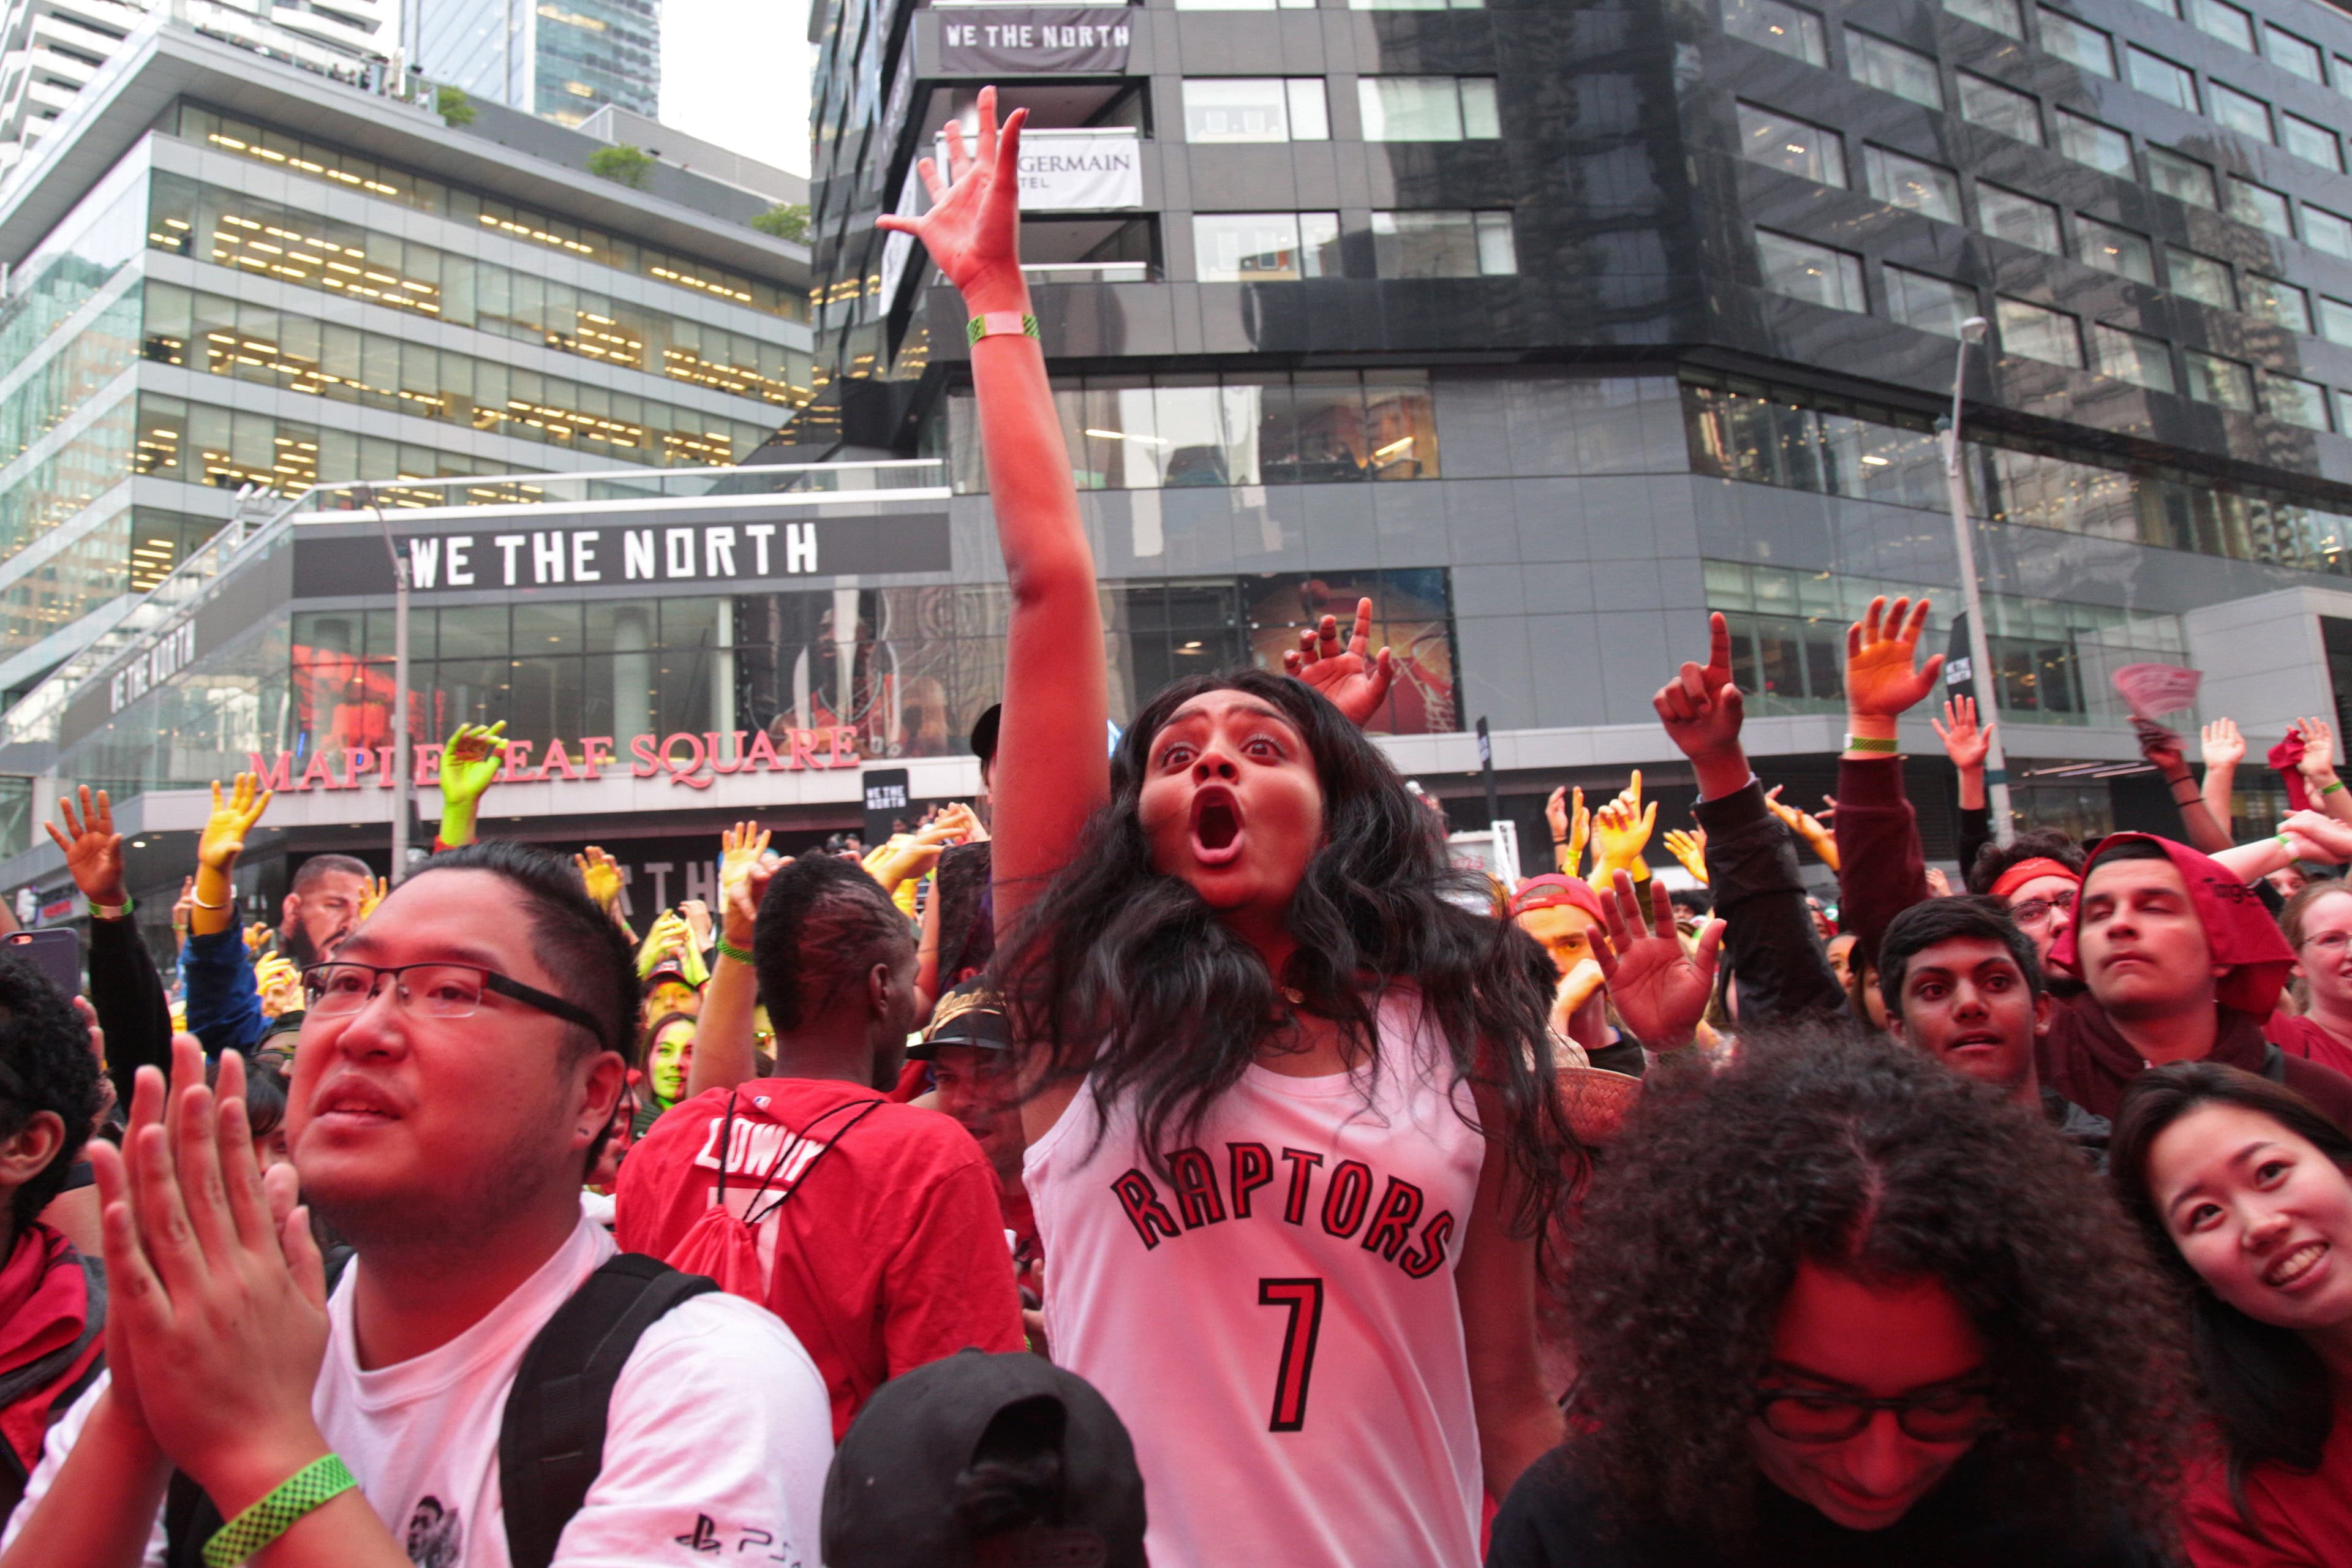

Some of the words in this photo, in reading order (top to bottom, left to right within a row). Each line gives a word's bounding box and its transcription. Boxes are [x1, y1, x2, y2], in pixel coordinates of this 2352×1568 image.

[946, 25, 977, 47] WE
[985, 24, 1033, 48] THE
[1042, 26, 1129, 48] NORTH
[1017, 154, 1130, 172] GERMAIN
[1019, 177, 1050, 189] TEL
[410, 535, 475, 589] WE
[494, 529, 601, 586] THE
[624, 521, 818, 580] NORTH
[491, 736, 612, 783] EAF
[630, 726, 861, 788] SQUARE
[1110, 1142, 1455, 1279] RAPTORS
[1258, 1278, 1324, 1432] 7
